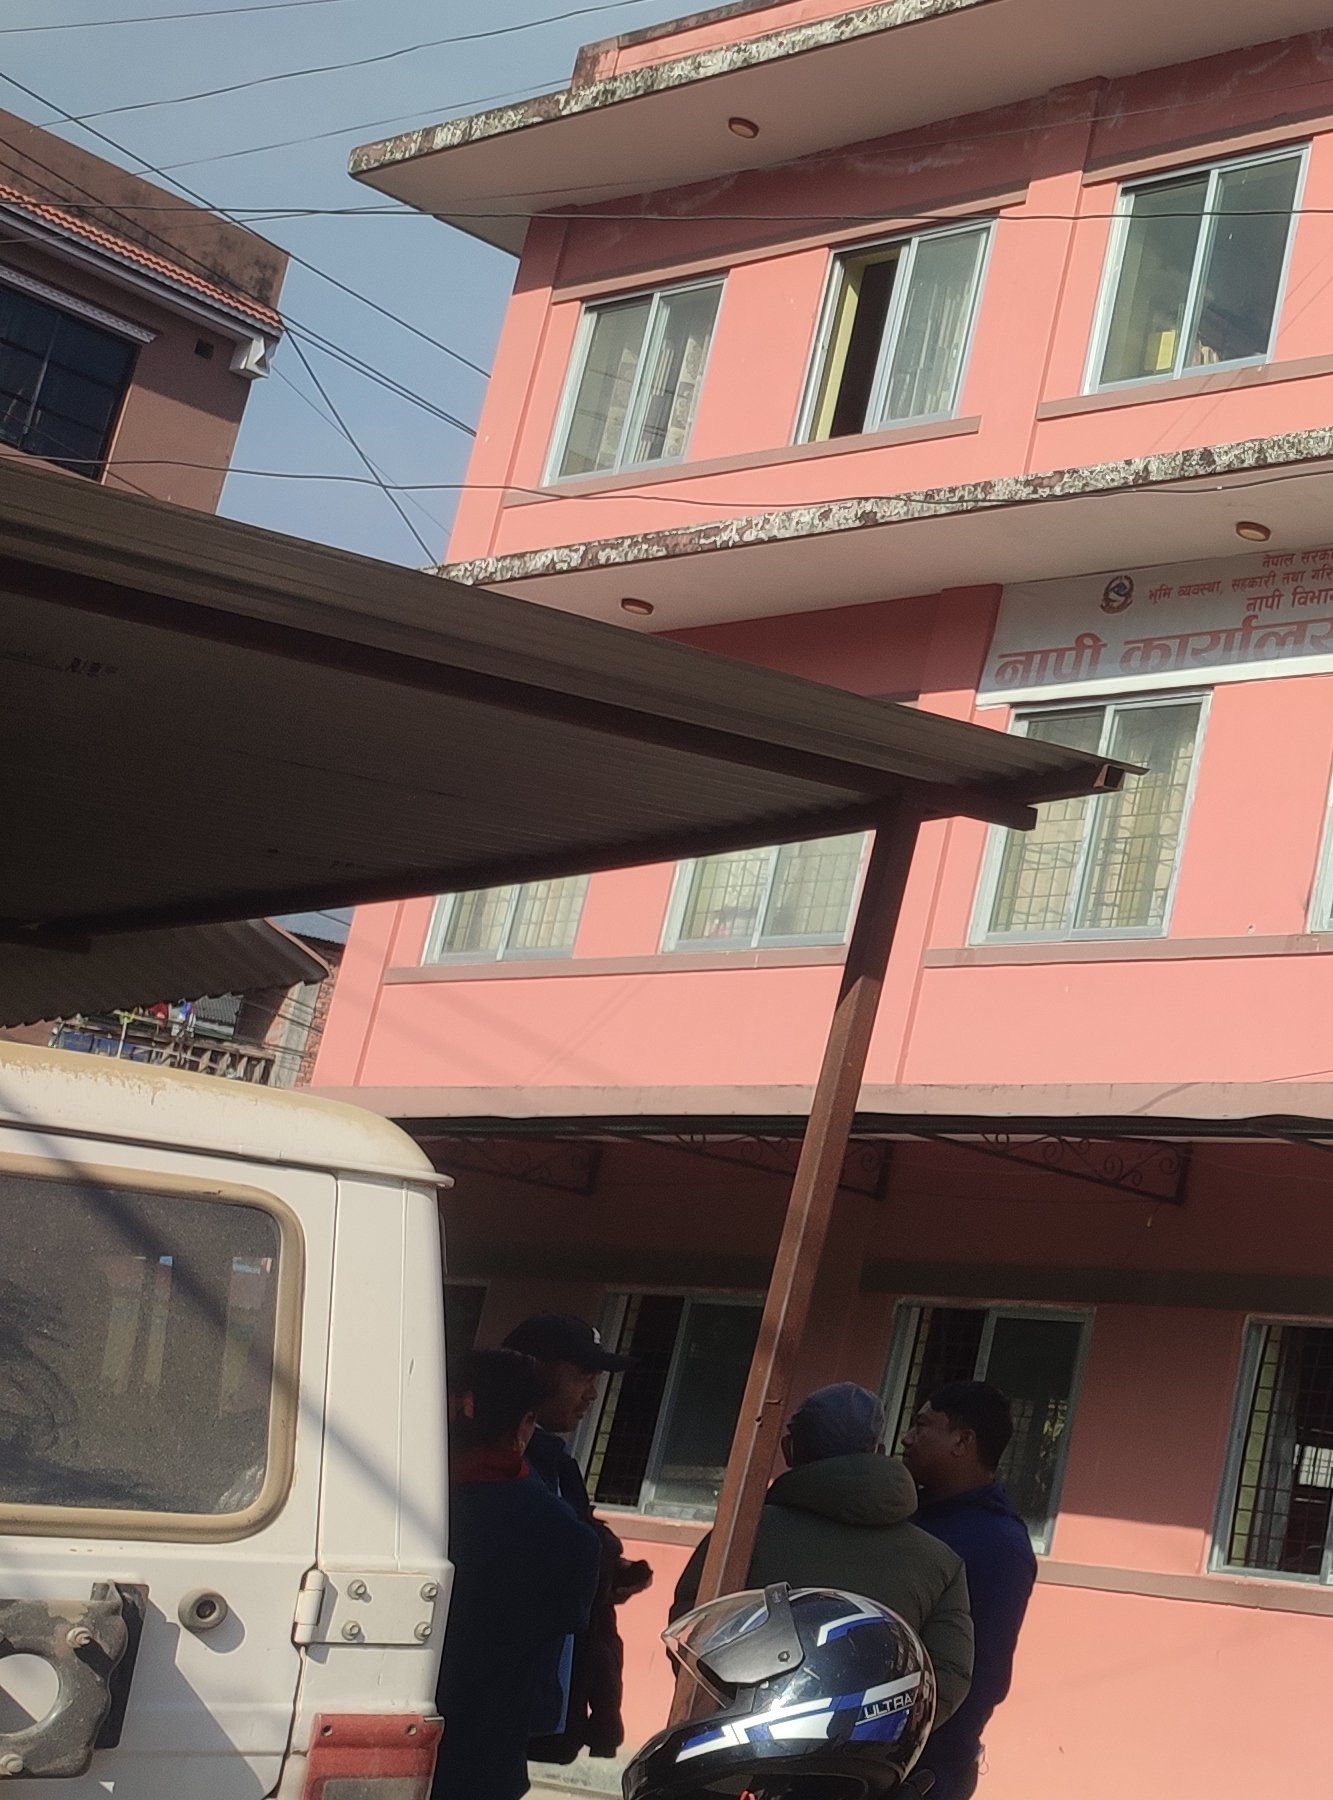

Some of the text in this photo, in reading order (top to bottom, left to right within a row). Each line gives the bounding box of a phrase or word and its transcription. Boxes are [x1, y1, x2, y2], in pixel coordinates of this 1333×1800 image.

[1262, 551, 1295, 569] नेपाल
[1149, 584, 1172, 605] भूमि
[1232, 571, 1276, 592] सहकारी
[1282, 570, 1305, 586] तथा
[1246, 590, 1284, 613] नापी
[994, 632, 1108, 688] नापी
[864, 1692, 912, 1719] ULTRA
